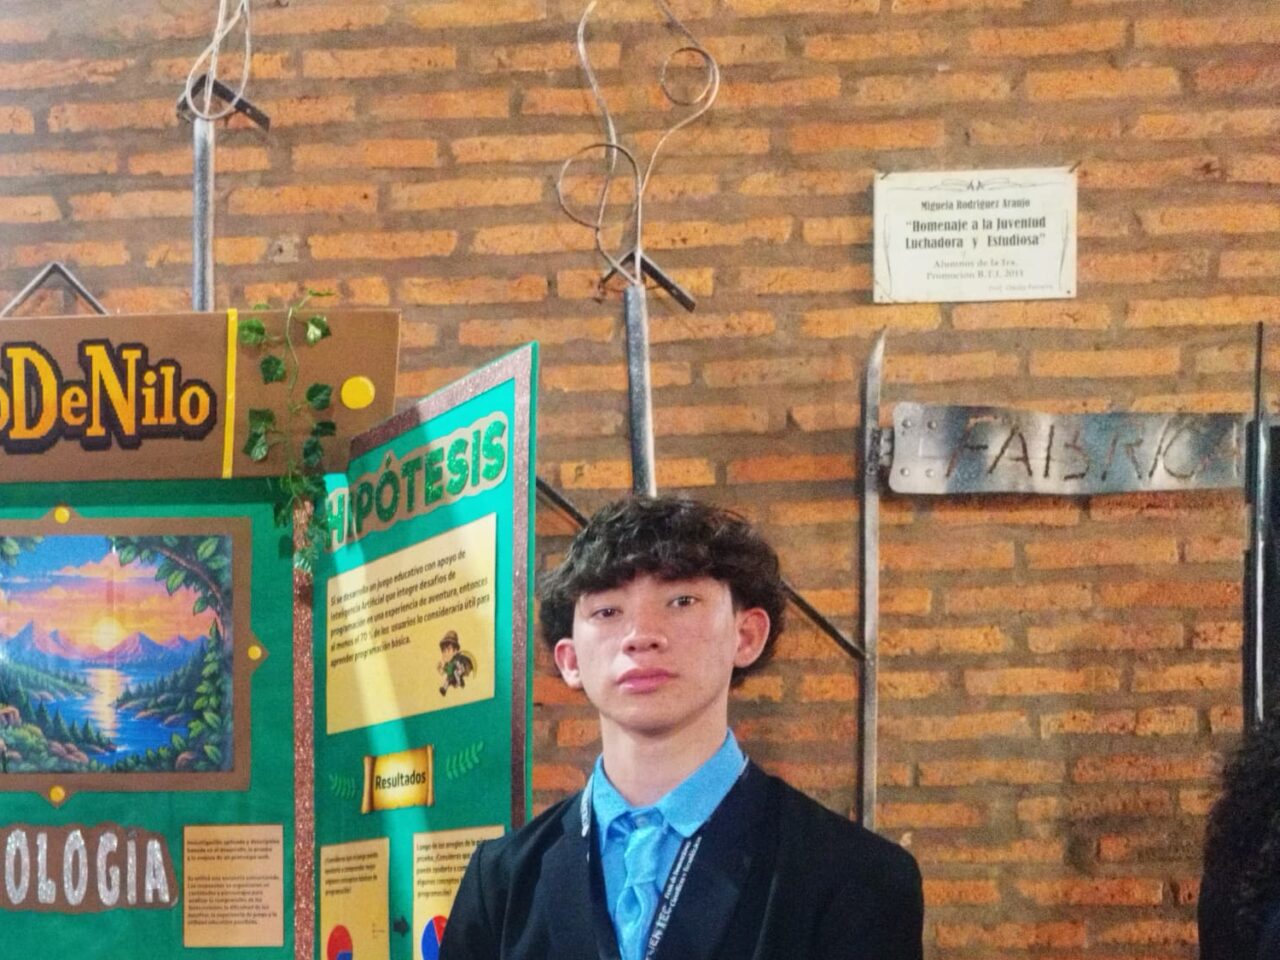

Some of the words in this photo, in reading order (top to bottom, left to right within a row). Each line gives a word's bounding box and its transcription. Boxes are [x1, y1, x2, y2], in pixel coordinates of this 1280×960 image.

[972, 220, 978, 230] a
[983, 218, 992, 230] la
[997, 217, 1046, 230] Juventud
[905, 236, 964, 249] Luchadora
[972, 237, 978, 248] y
[326, 420, 506, 549] HIPÓTESIS
[394, 567, 423, 582] educativo
[425, 562, 436, 571] con
[437, 556, 457, 570] apoyo
[458, 550, 466, 559] de
[385, 600, 418, 619] experiencia
[459, 577, 488, 594] entonces
[396, 584, 418, 600] integre
[448, 570, 456, 580] de
[375, 769, 426, 790] Resultados
